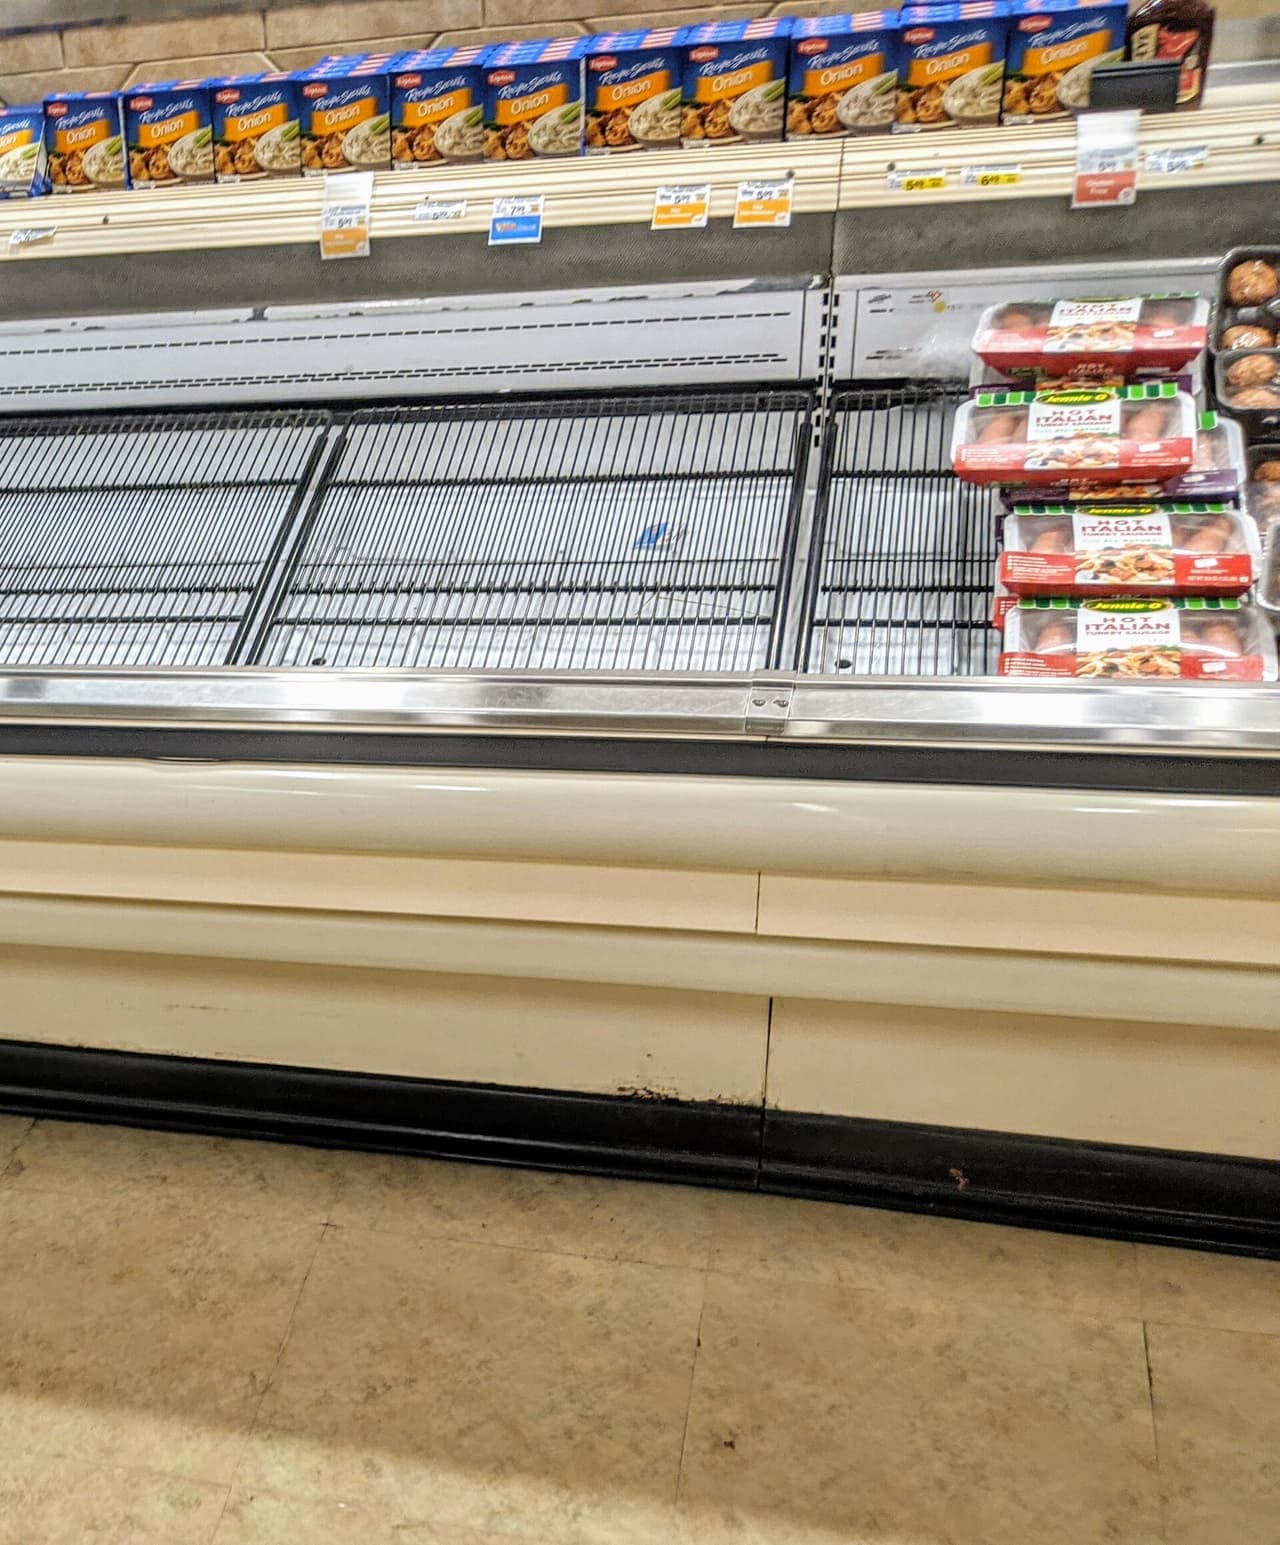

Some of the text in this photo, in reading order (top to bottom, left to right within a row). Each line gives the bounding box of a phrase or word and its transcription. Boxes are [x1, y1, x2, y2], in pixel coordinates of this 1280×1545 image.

[926, 53, 970, 75] Onion
[712, 71, 753, 92] Onion
[821, 64, 864, 85] Onion
[612, 80, 650, 100] Onion
[417, 97, 454, 117] Onion
[511, 94, 548, 115] Onion
[237, 112, 271, 131] Onion
[325, 106, 360, 125] Onion
[66, 127, 96, 144] Onion
[151, 119, 183, 138] Onion
[1036, 414, 1113, 423] ITALIAN
[1084, 623, 1171, 631] ITALIAN
